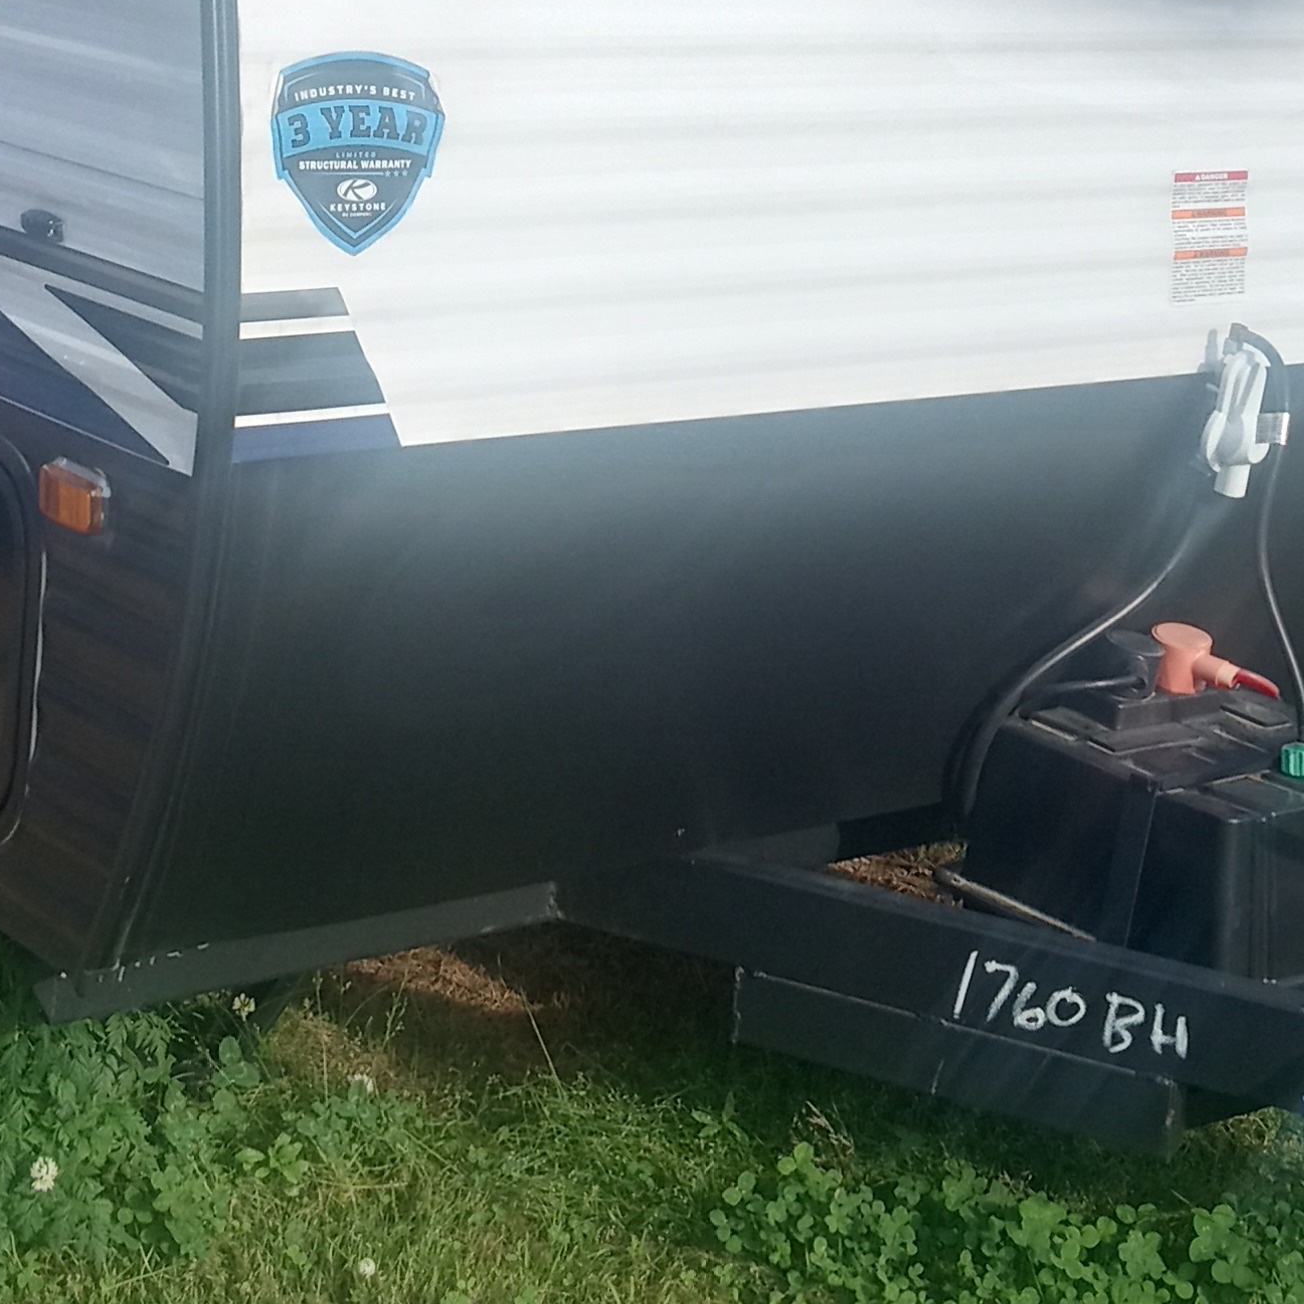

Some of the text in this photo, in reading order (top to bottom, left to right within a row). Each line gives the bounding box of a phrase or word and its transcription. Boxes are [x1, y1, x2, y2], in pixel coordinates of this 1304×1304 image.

[294, 84, 416, 102] INDUSTRY'S BEST
[287, 104, 428, 149] 3 YEAR
[298, 158, 412, 171] STRUCTURAL WARRANTY
[329, 201, 387, 213] KEYSTONE
[952, 950, 1189, 1060] 1760 BH
